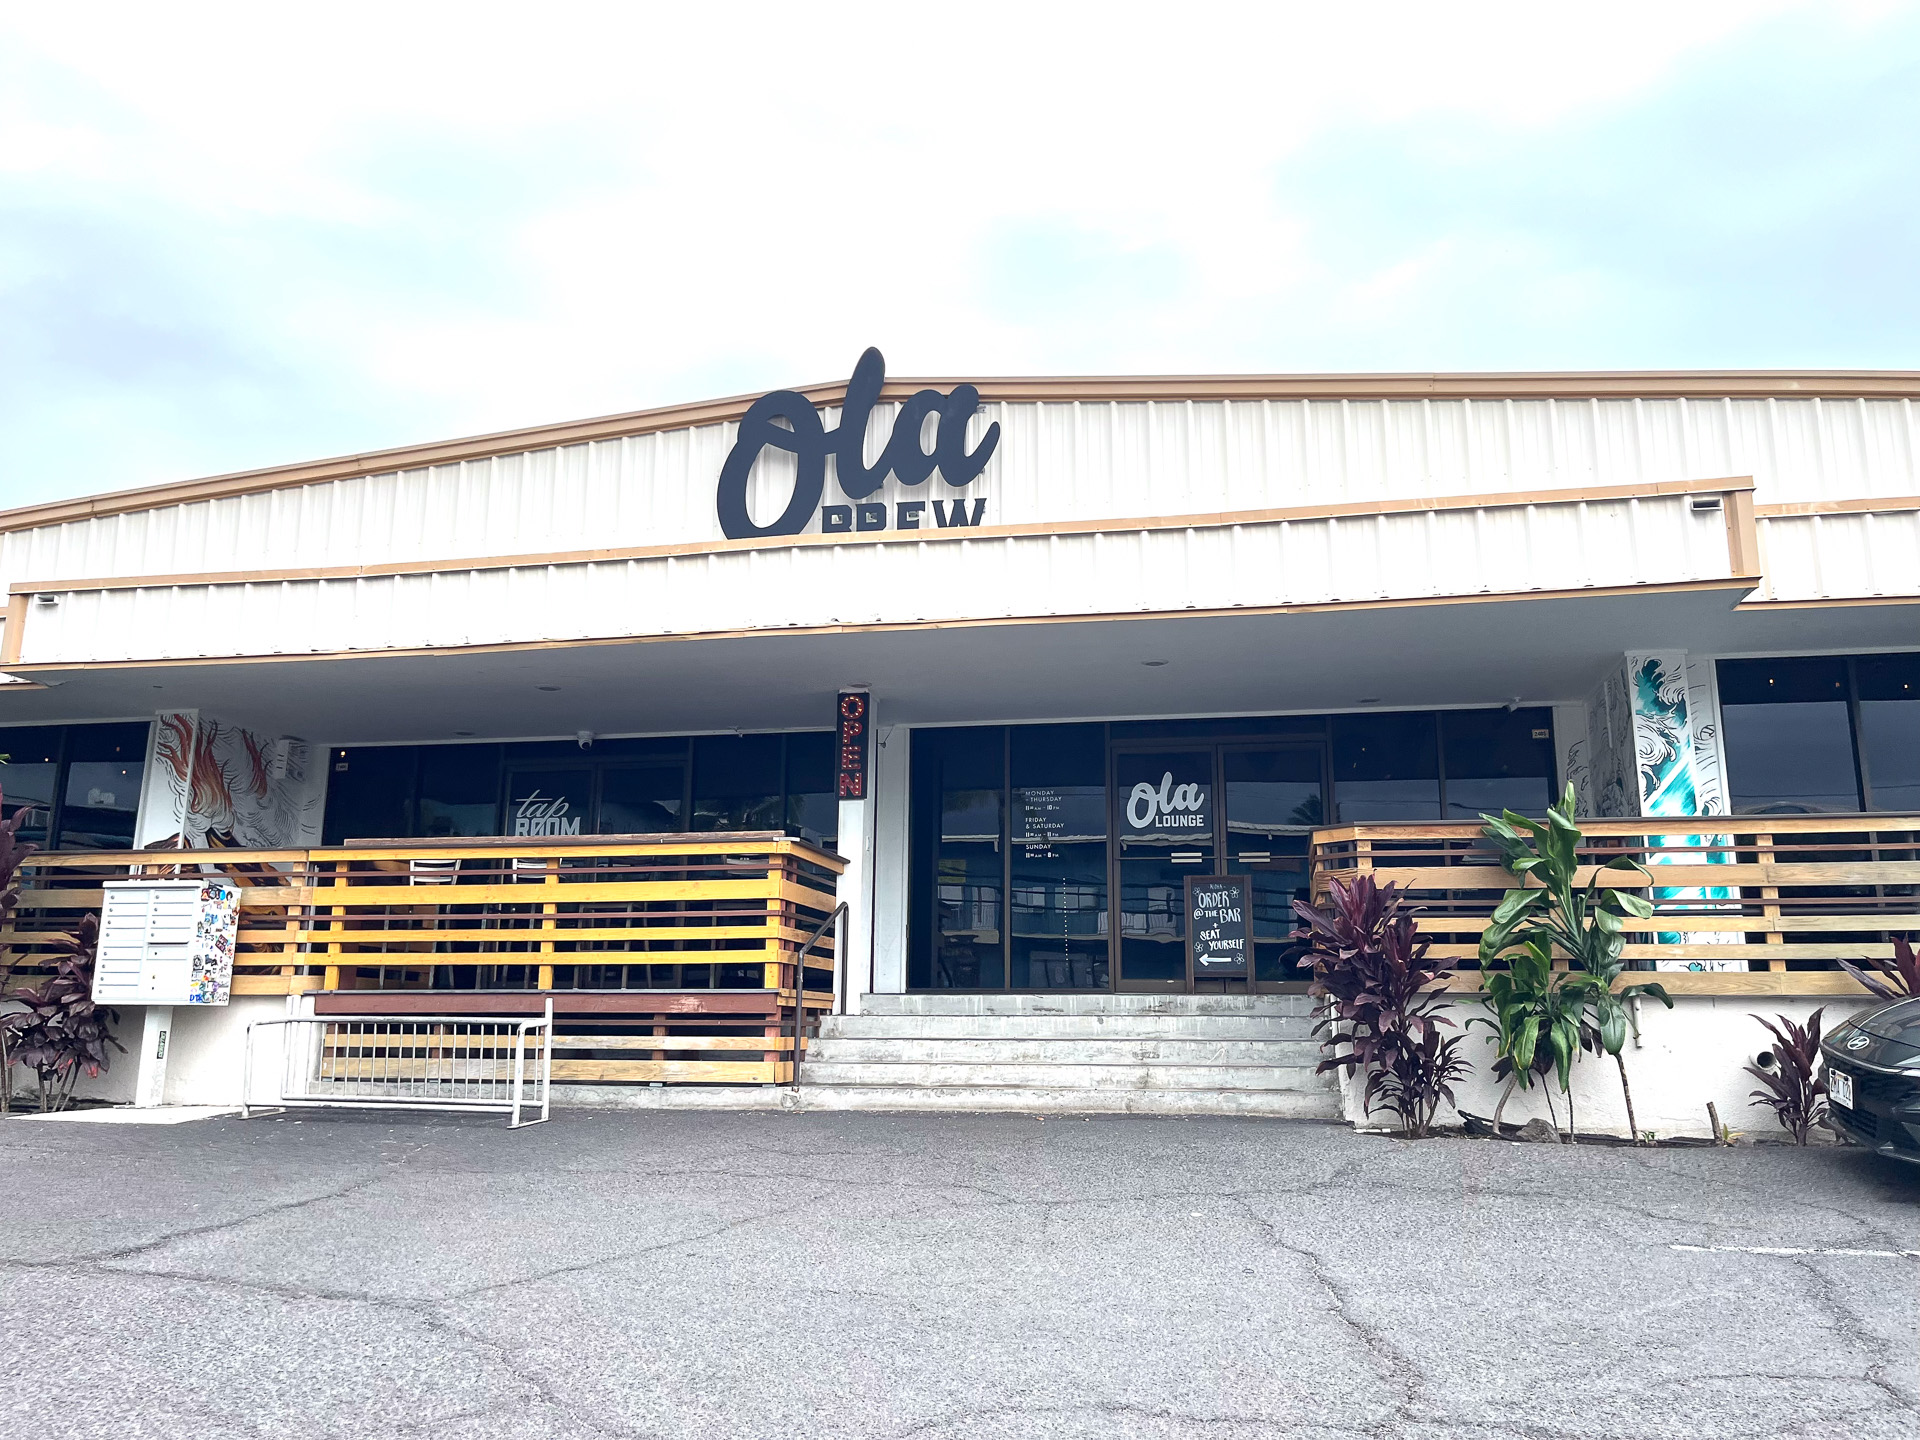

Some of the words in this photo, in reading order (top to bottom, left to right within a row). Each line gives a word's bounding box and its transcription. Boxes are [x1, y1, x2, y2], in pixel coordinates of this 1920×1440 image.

[716, 346, 1000, 540] Ola
[839, 695, 865, 797] OPEN
[1126, 771, 1205, 829] Ola
[515, 789, 570, 834] tap
[514, 817, 581, 836] ROOM
[1155, 814, 1204, 828] LOUNGE
[1198, 891, 1230, 908] ORDER
[1204, 910, 1219, 918] THE
[1219, 907, 1241, 923] BAR
[1199, 928, 1221, 940] SEAT
[1208, 938, 1245, 951] YOURSELF
